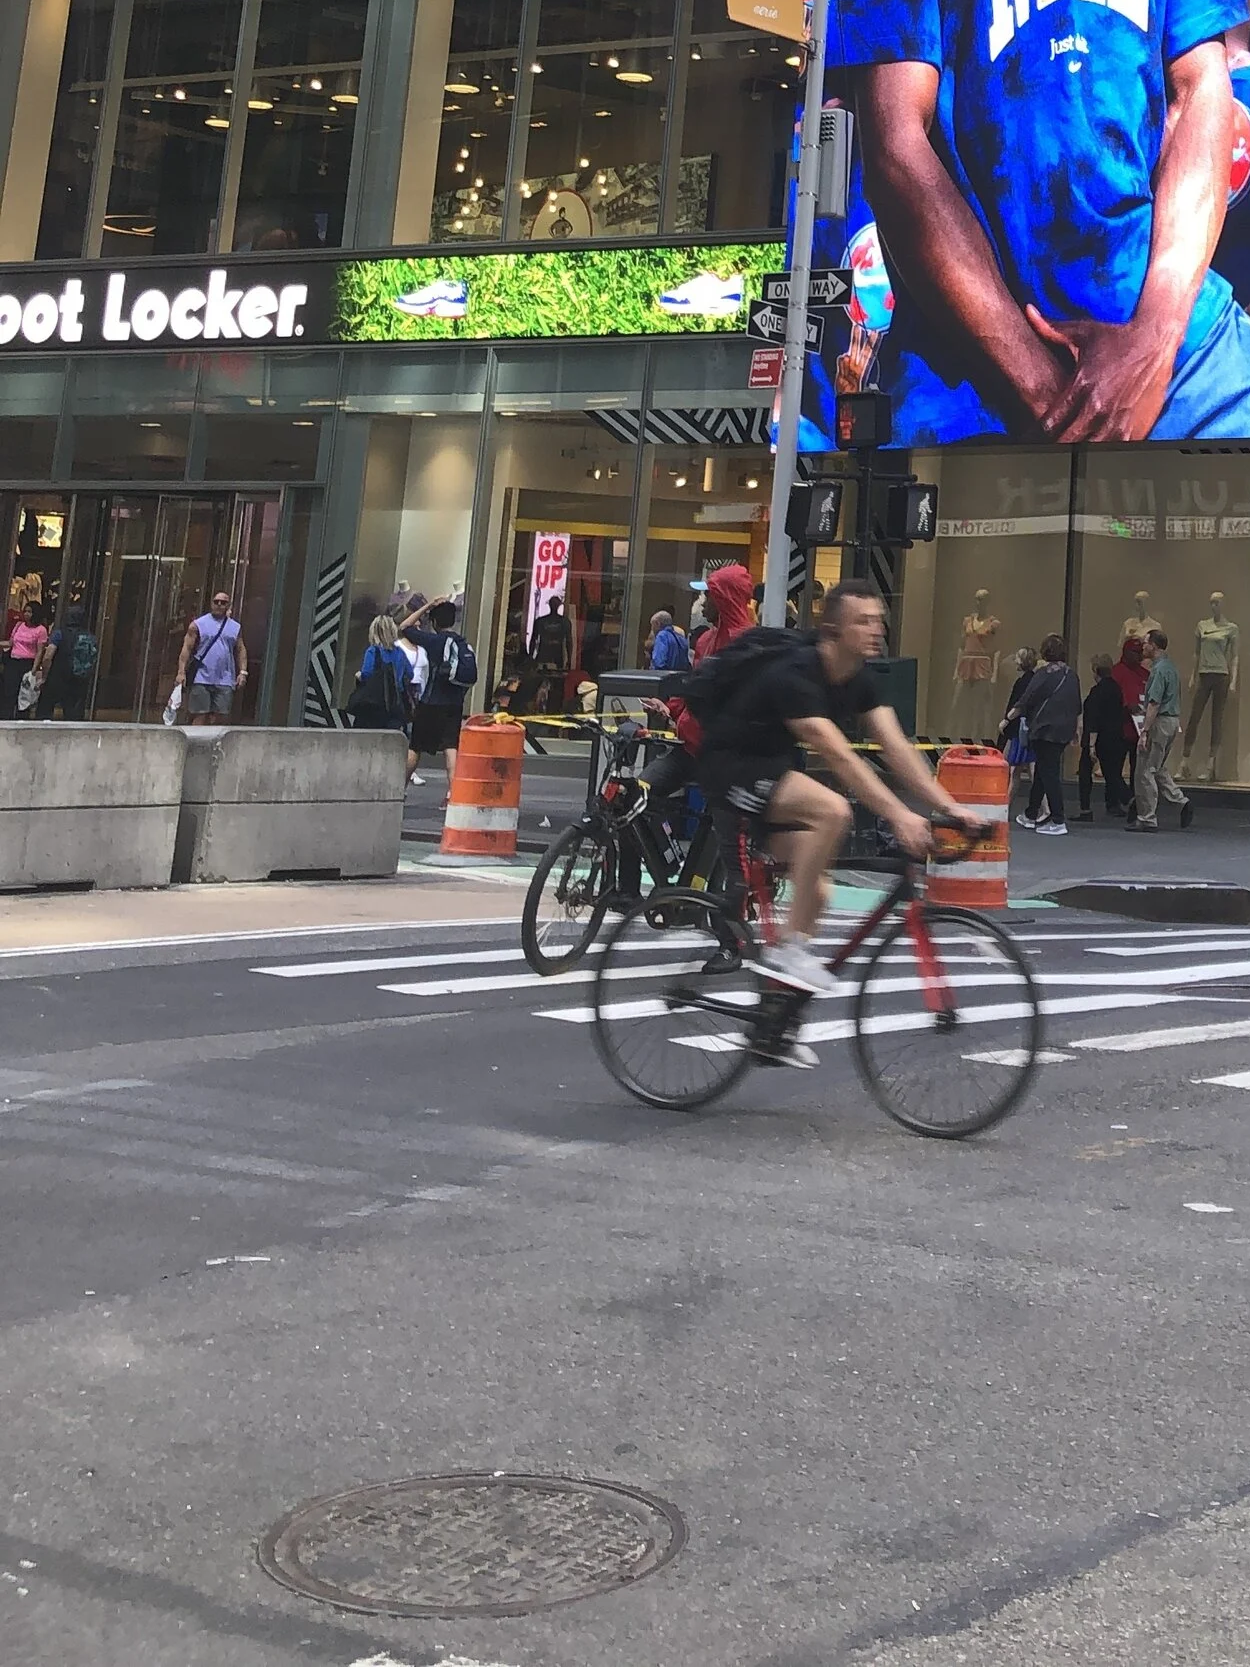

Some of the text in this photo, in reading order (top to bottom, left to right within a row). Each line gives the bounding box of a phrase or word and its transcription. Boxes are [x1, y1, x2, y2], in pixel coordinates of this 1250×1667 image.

[774, 280, 840, 298] ON WAY
[102, 269, 308, 342] Locker
[760, 314, 783, 332] ONE
[538, 540, 566, 563] GO
[535, 565, 564, 589] UP
